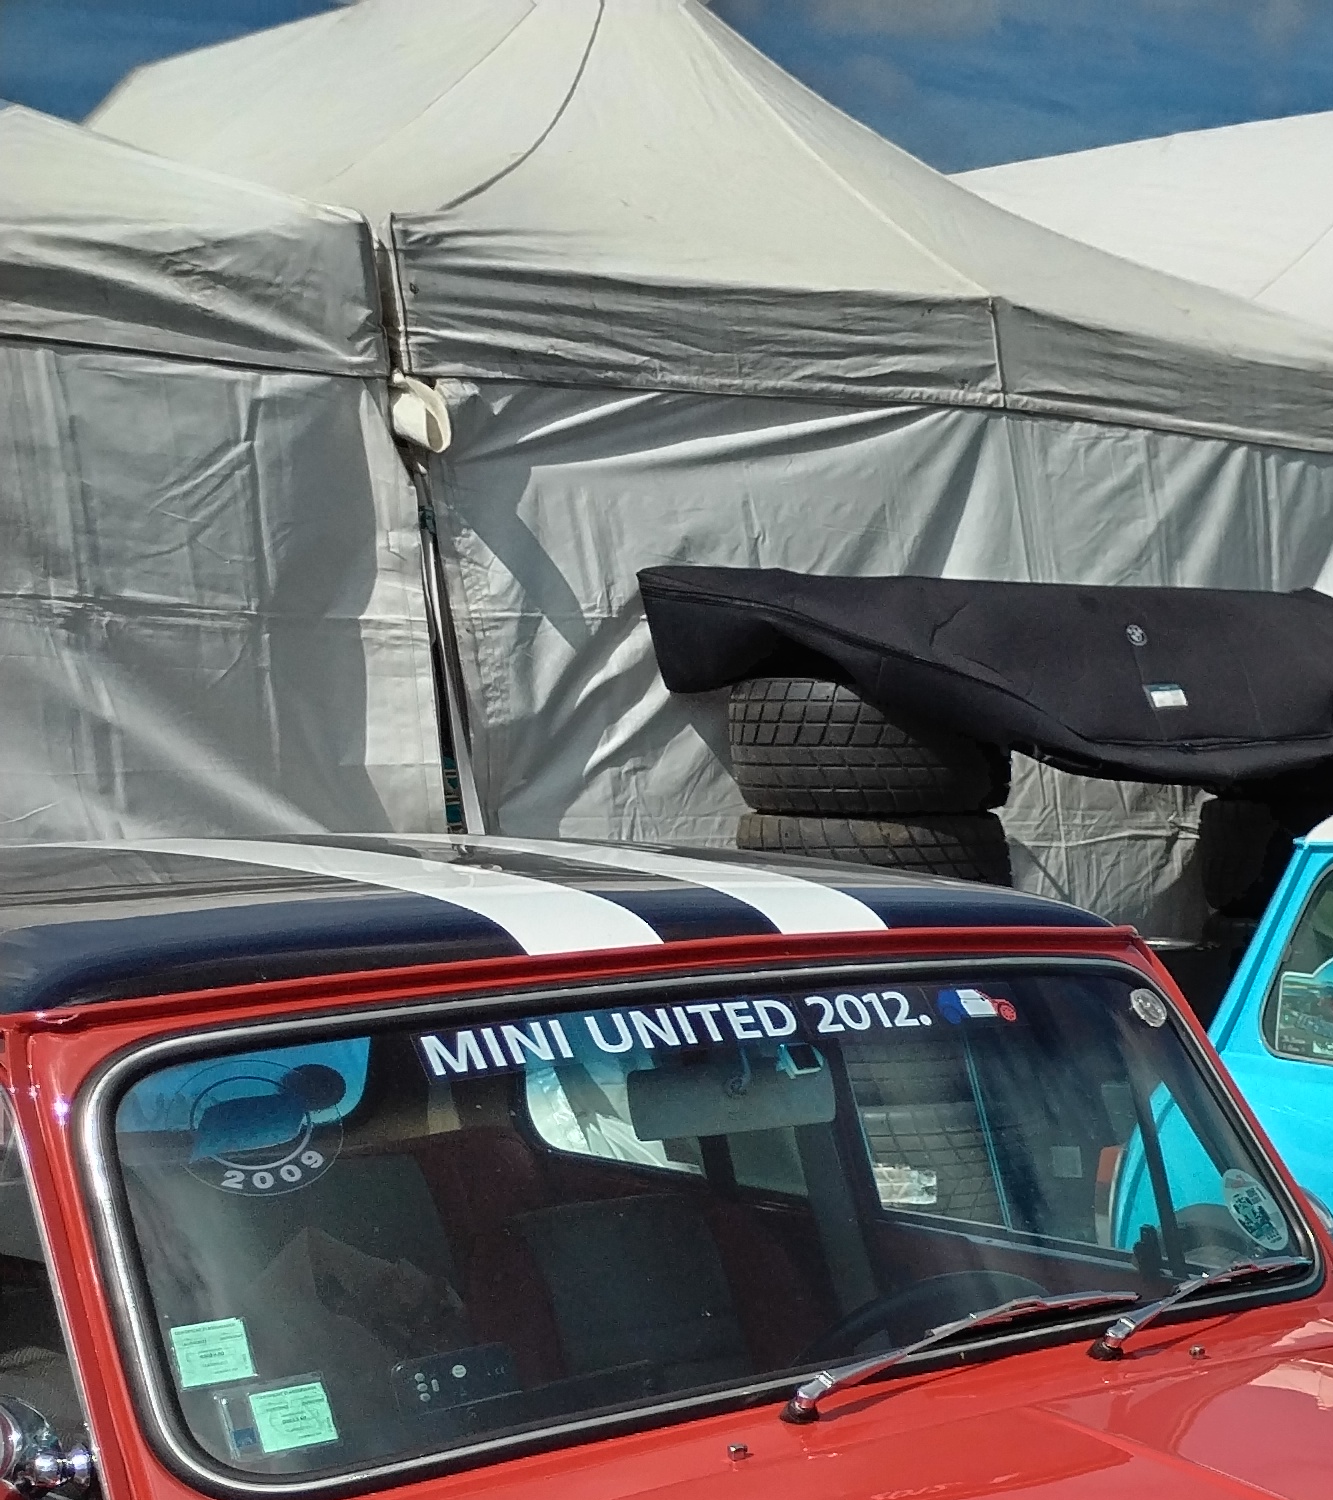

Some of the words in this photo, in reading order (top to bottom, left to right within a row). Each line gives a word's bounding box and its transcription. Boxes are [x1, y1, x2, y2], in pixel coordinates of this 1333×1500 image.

[420, 1019, 574, 1076] MINI
[585, 999, 798, 1055] UNITED
[805, 991, 932, 1034] 2012.
[221, 1150, 325, 1189] 2009
